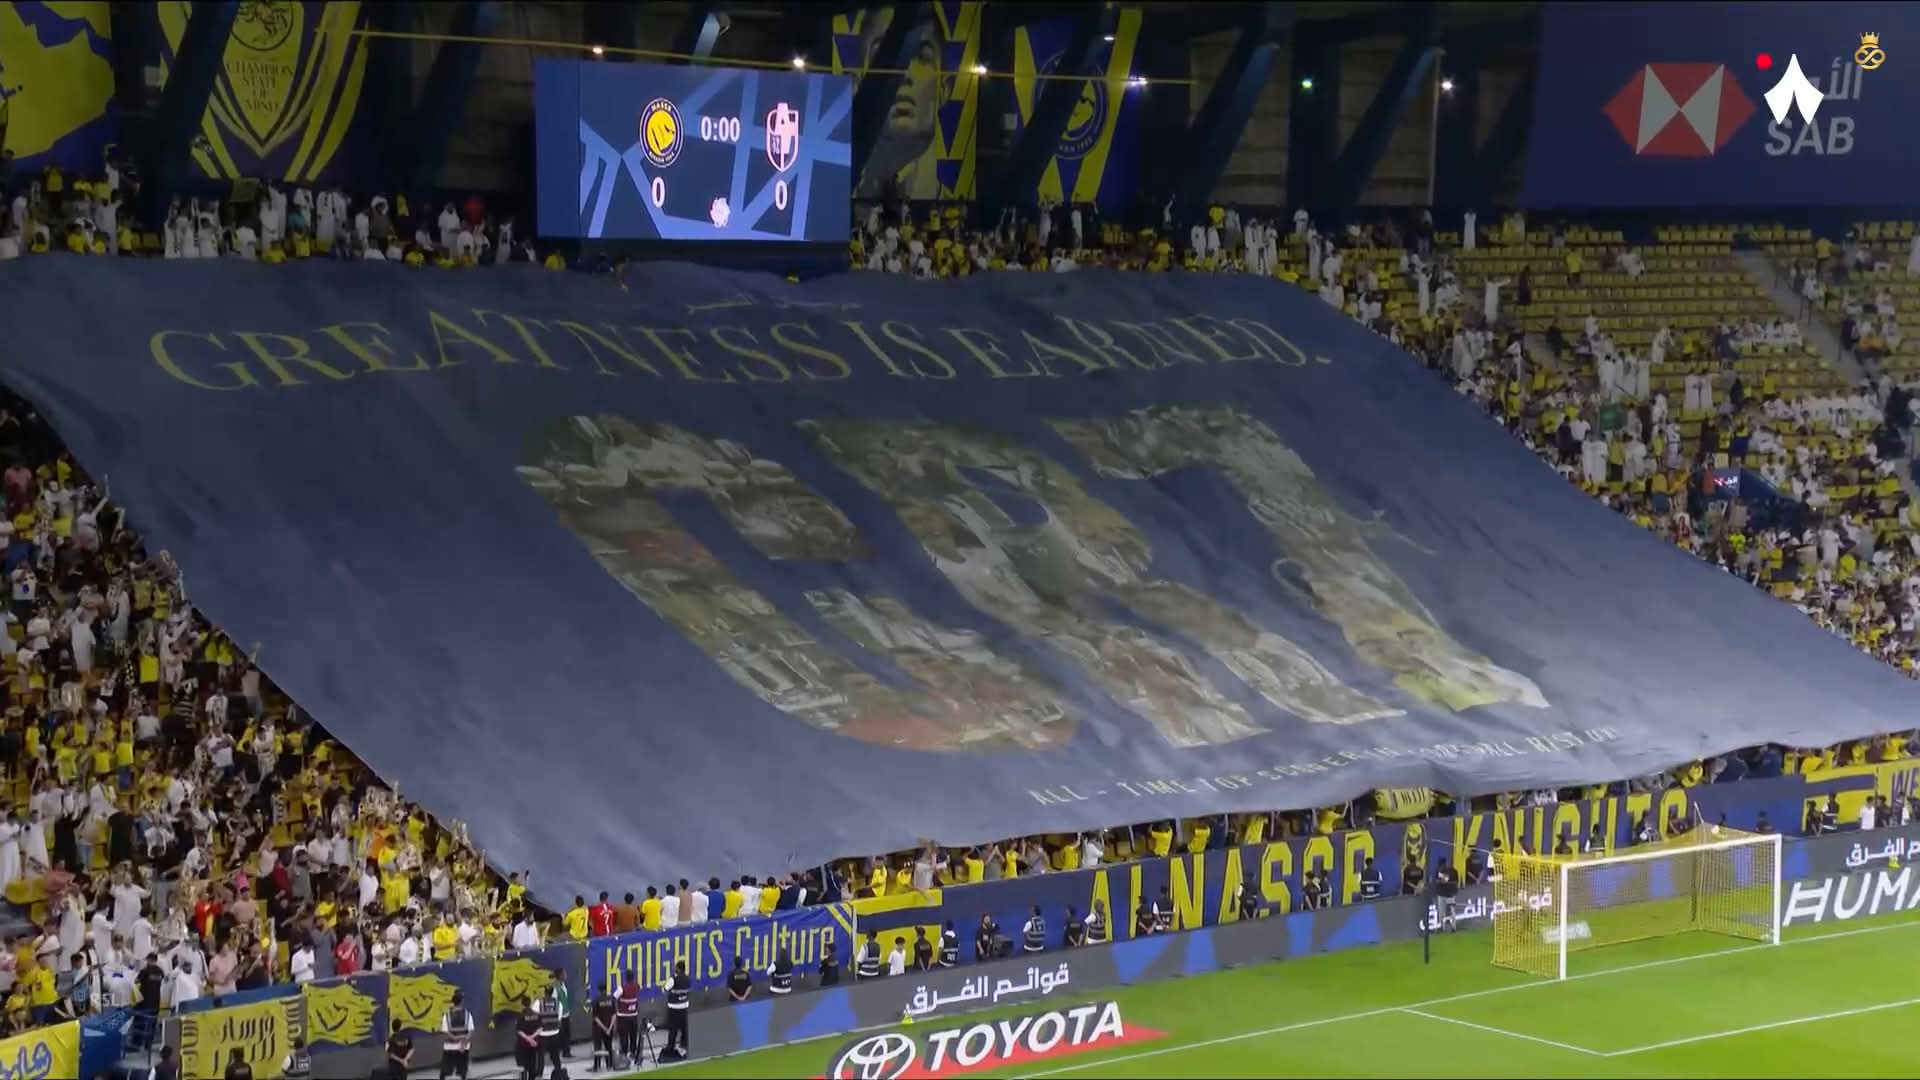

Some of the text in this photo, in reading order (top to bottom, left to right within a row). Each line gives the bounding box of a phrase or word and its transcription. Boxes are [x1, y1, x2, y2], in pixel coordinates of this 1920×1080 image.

[701, 115, 741, 143] 0:00
[1764, 116, 1856, 156] SAB
[652, 176, 666, 208] 0
[775, 180, 788, 210] 0
[149, 308, 1333, 391] GREATNESS IS EARNED.
[1027, 784, 1089, 806] ALL
[1116, 778, 1198, 797] TIME
[606, 920, 836, 995] KNIGHTS Culture
[912, 963, 1070, 1015] قوائم الفرق
[927, 1001, 1125, 1072] TOYOTA
